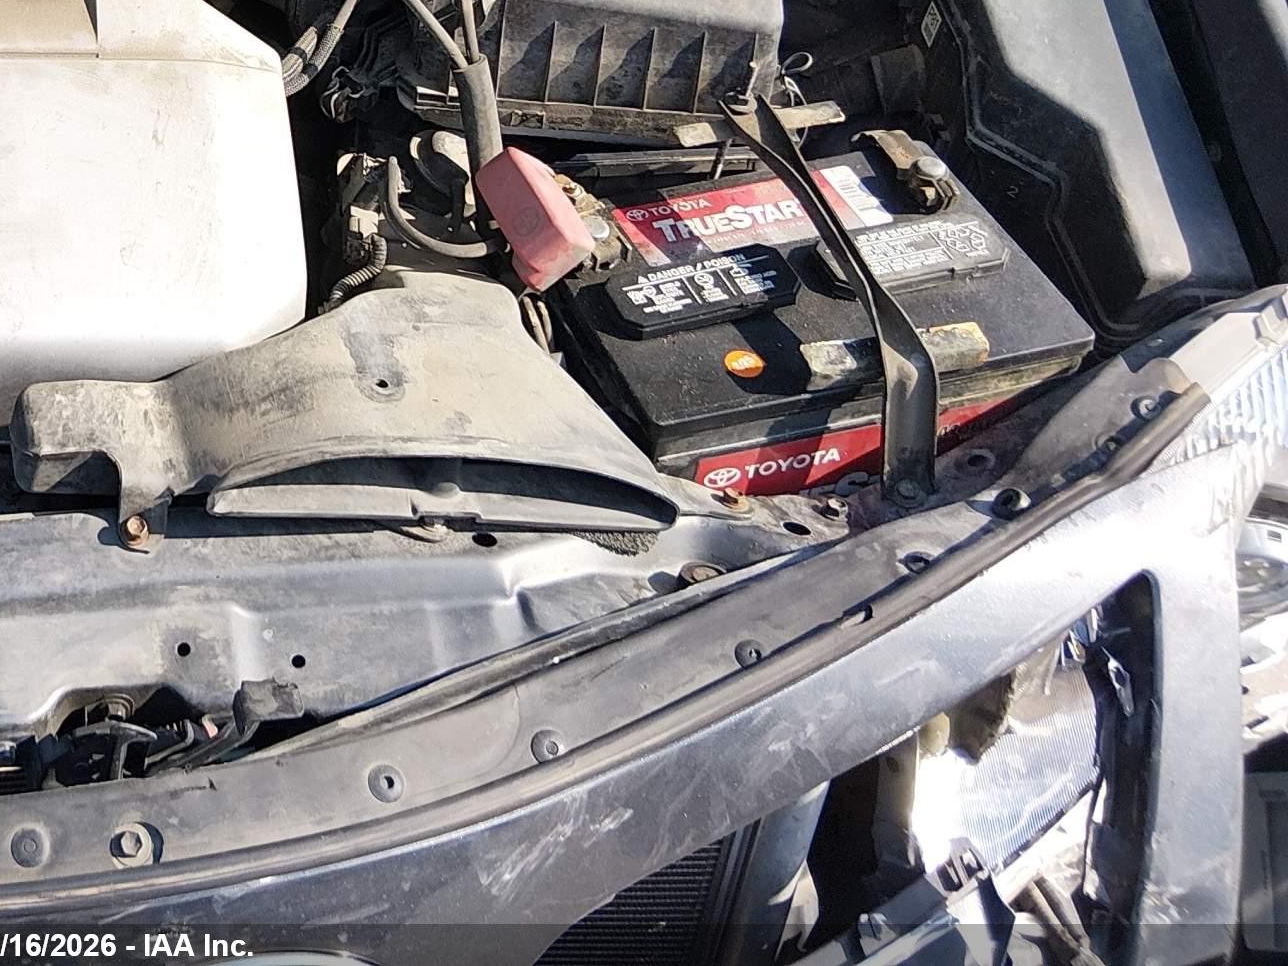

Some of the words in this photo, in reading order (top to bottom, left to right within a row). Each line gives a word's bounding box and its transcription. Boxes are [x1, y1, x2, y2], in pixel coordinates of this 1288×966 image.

[647, 197, 712, 218] TOYOTA
[647, 264, 695, 282] DANGER
[703, 253, 747, 269] POISON
[744, 447, 842, 480] TOYOTA
